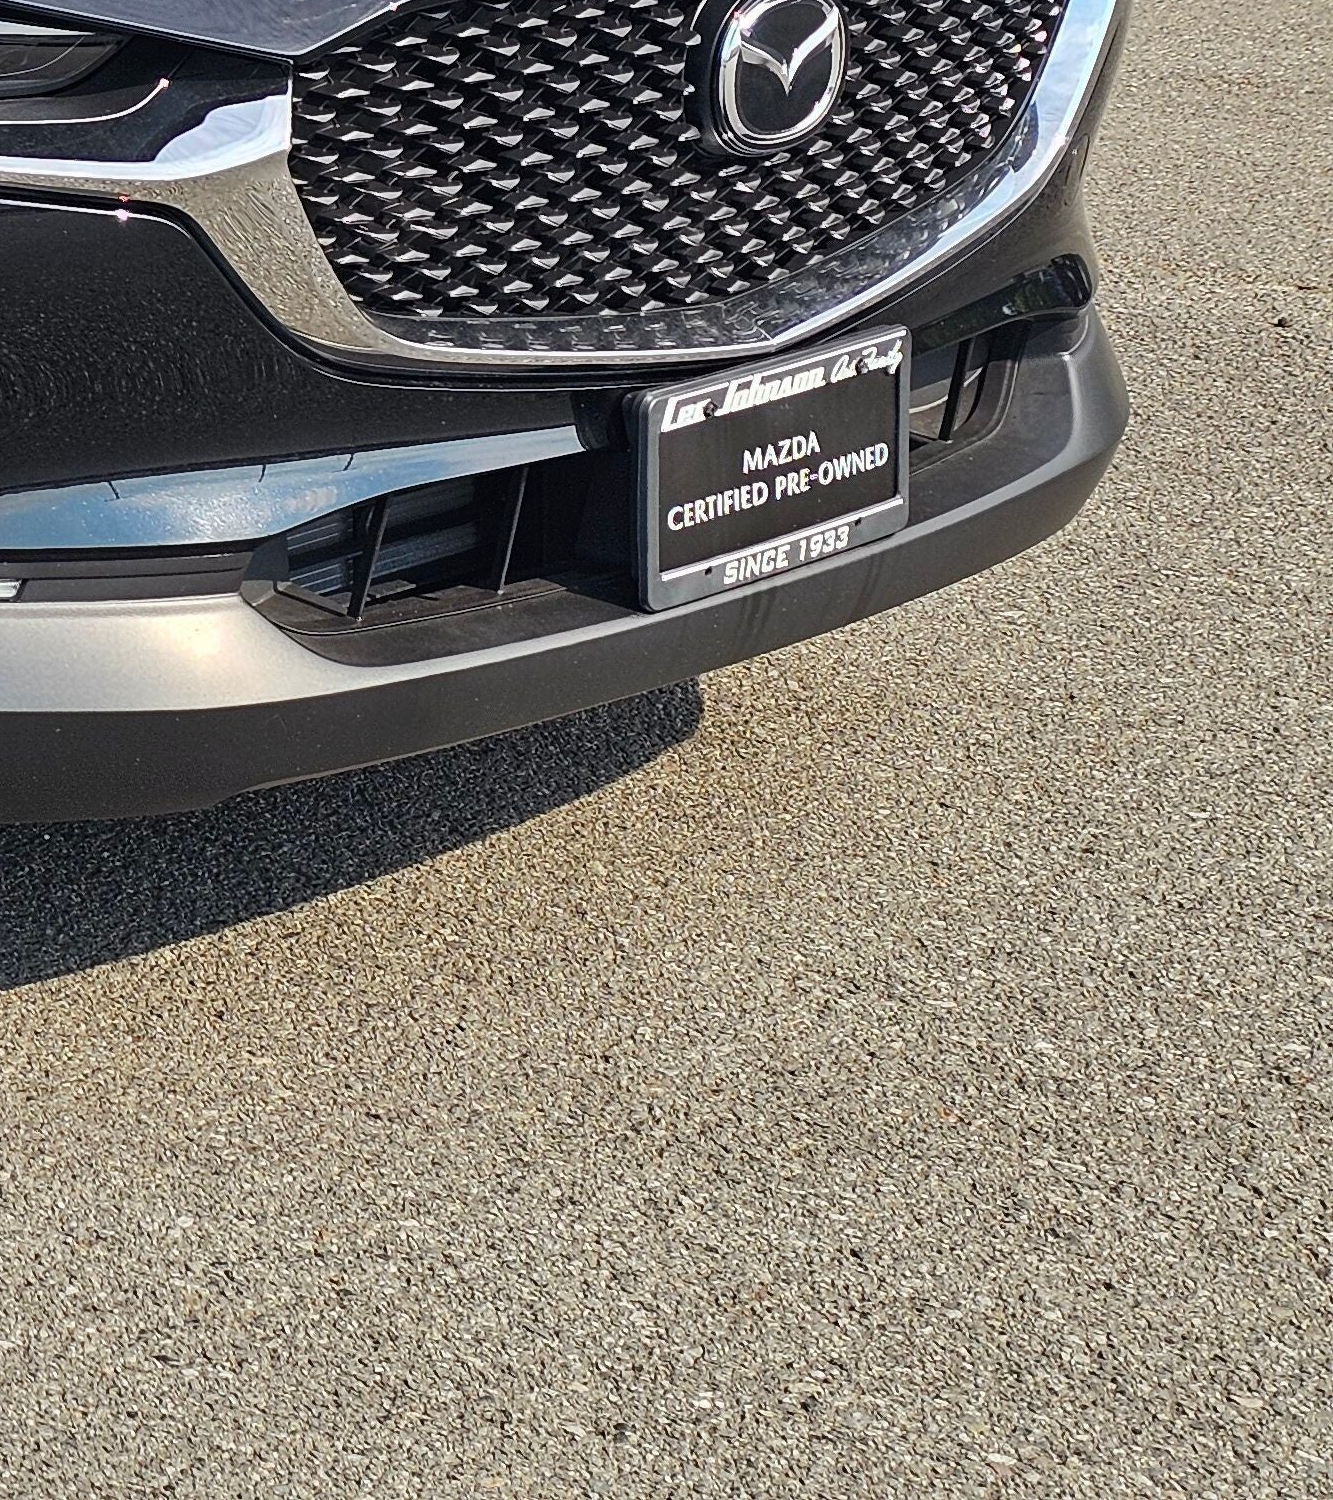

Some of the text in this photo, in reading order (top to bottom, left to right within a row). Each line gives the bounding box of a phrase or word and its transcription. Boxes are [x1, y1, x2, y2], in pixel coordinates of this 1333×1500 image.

[713, 365, 827, 417] Johnson
[742, 430, 821, 475] MAZDA
[667, 442, 889, 531] CERTIFIED PRE-OWNED
[723, 525, 851, 585] SINCE 1933
